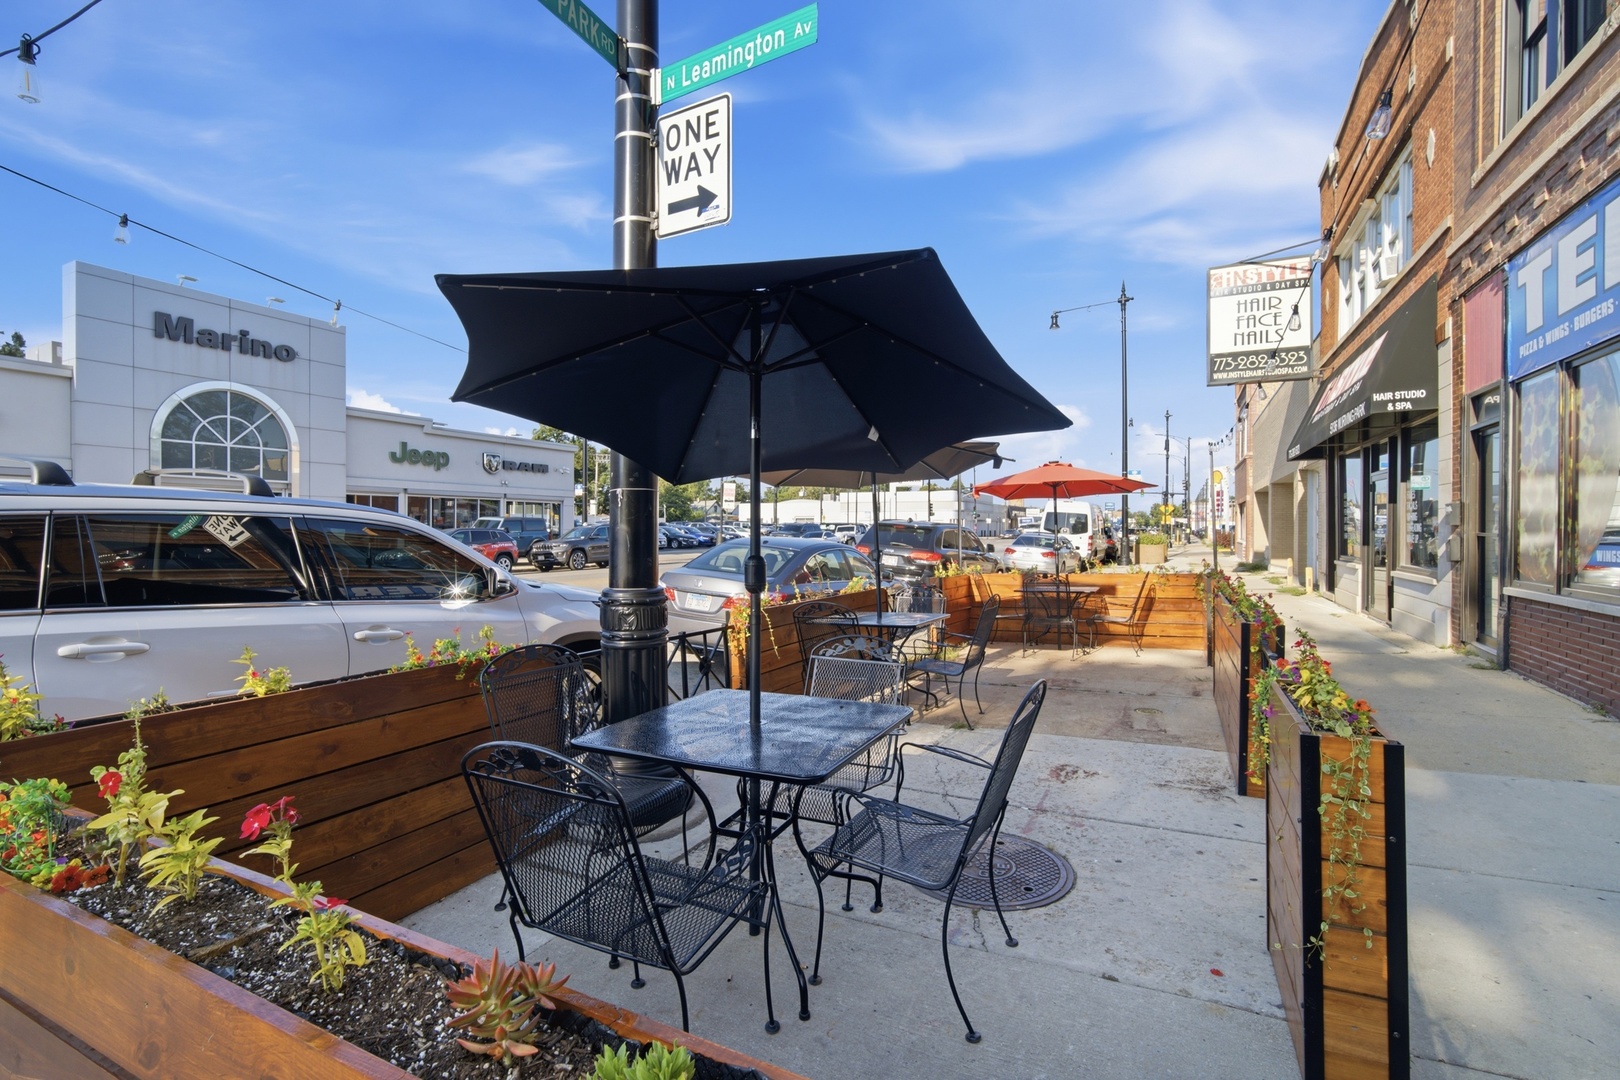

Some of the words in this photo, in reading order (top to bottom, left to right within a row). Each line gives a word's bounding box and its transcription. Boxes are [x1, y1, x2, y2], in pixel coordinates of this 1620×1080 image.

[557, 0, 600, 48] PARK
[601, 32, 615, 55] RD
[667, 75, 675, 90] N
[682, 29, 785, 87] Leamington
[794, 21, 812, 39] Av
[666, 109, 720, 151] ONE
[664, 143, 721, 187] WAY
[1232, 285, 1262, 294] STUDIO
[1275, 281, 1291, 290] DAY
[1237, 297, 1282, 313] HAIR
[1236, 312, 1282, 329] FACE
[1519, 338, 1538, 359] PIZZA
[1538, 335, 1545, 349] &
[1545, 321, 1570, 346] WINGS
[1573, 298, 1614, 332] BURGERS
[154, 310, 296, 363] Marino
[1234, 328, 1284, 346] NAILS
[1213, 351, 1308, 371] 773-282323
[1373, 391, 1394, 401] HAIR
[1394, 389, 1426, 400] STUDIO
[1387, 402, 1394, 411] &
[1395, 401, 1413, 410] SPA
[388, 441, 450, 471] Jeep
[502, 460, 549, 474] RAM
[1596, 550, 1620, 563] WINGS
